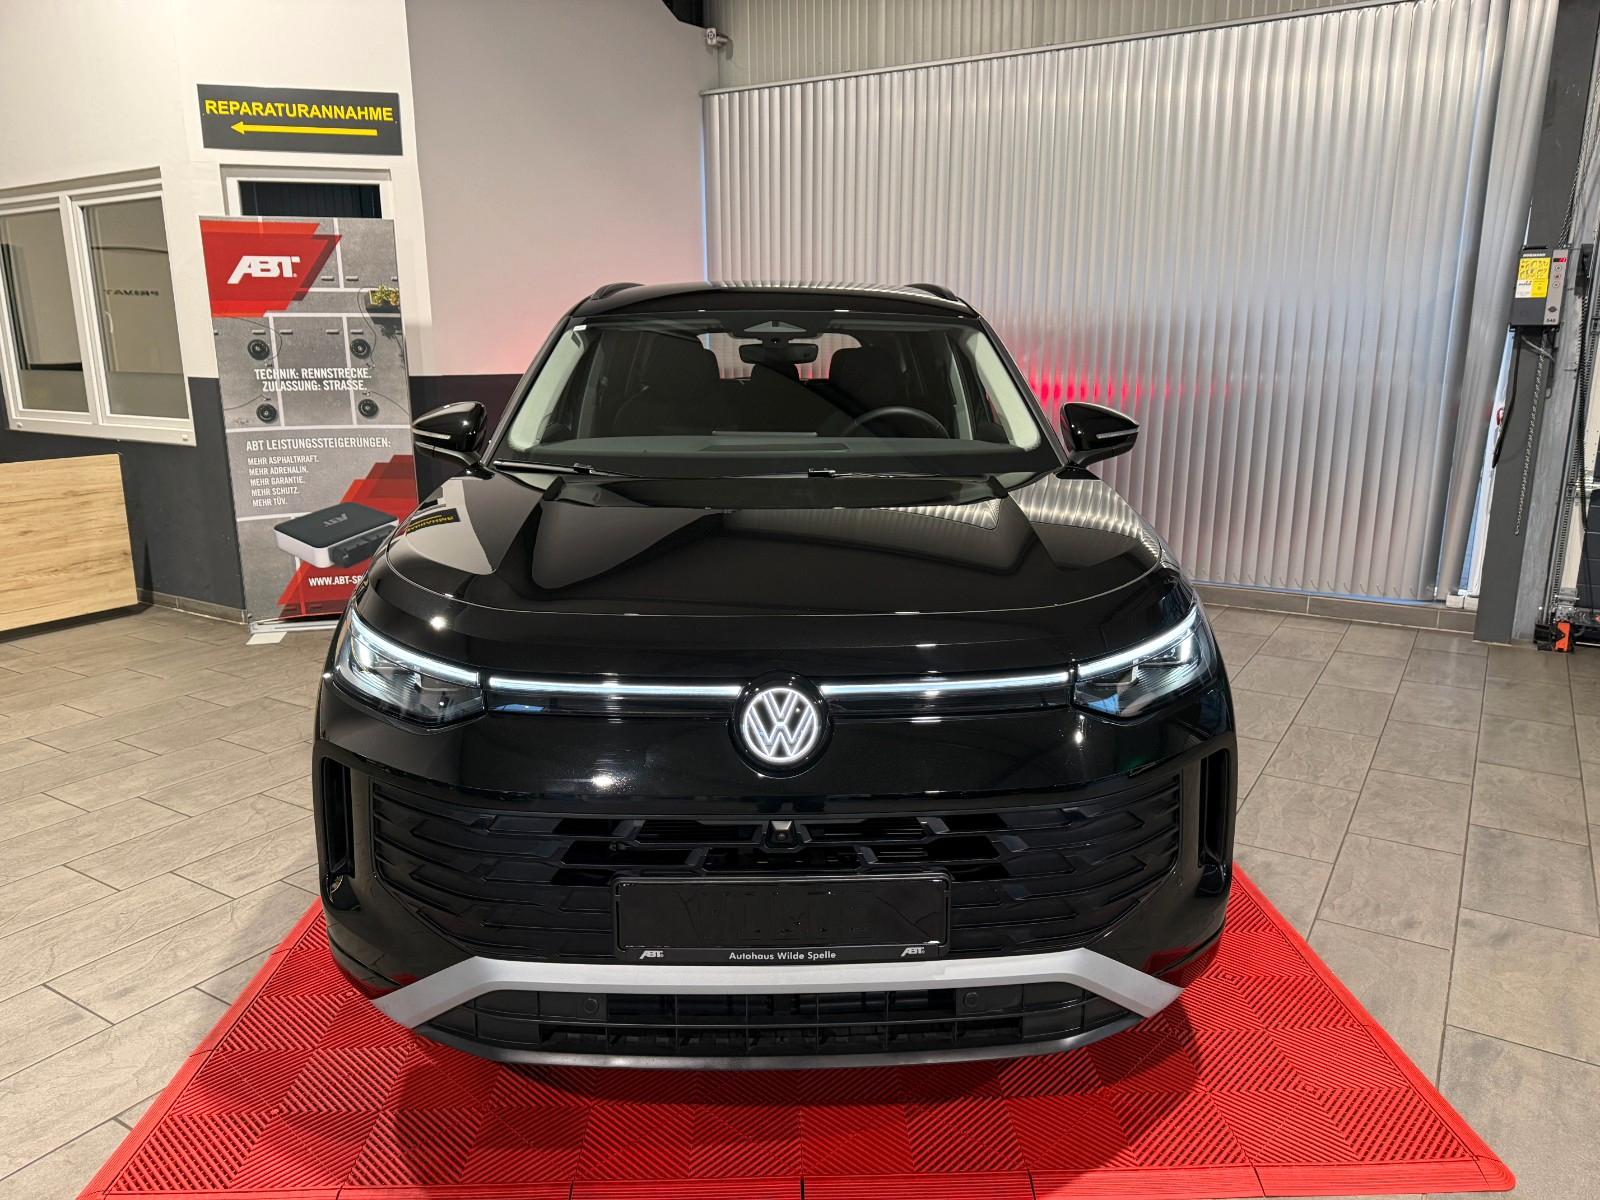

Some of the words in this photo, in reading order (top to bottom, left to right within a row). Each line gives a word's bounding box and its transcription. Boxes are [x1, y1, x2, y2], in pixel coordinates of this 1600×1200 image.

[204, 99, 394, 122] REPARATURANNAHME
[254, 368, 300, 380] TECHNIK:
[301, 367, 372, 379] RENNSTRECKE.
[262, 380, 321, 392] ZULASSUNG:
[323, 379, 368, 391] STRASSE.
[246, 440, 263, 451] ABT
[266, 437, 391, 450] LEISTUNGSSTEIGERUNGEN:
[247, 457, 268, 466] MEHR
[268, 455, 320, 465] ASPHALTKRAFT.
[248, 467, 269, 476] MEHR
[269, 466, 309, 475] ADRENALIN.
[250, 478, 270, 486] MEHR
[270, 476, 305, 485] GARANTIE.
[251, 488, 271, 497] MEHR
[271, 487, 300, 495] SCHUTZ.
[252, 498, 272, 507] MEHR
[273, 497, 288, 506] TÜV.
[728, 951, 774, 960] Autohaus
[776, 951, 805, 960] Wilde
[807, 950, 837, 961] Spelle
